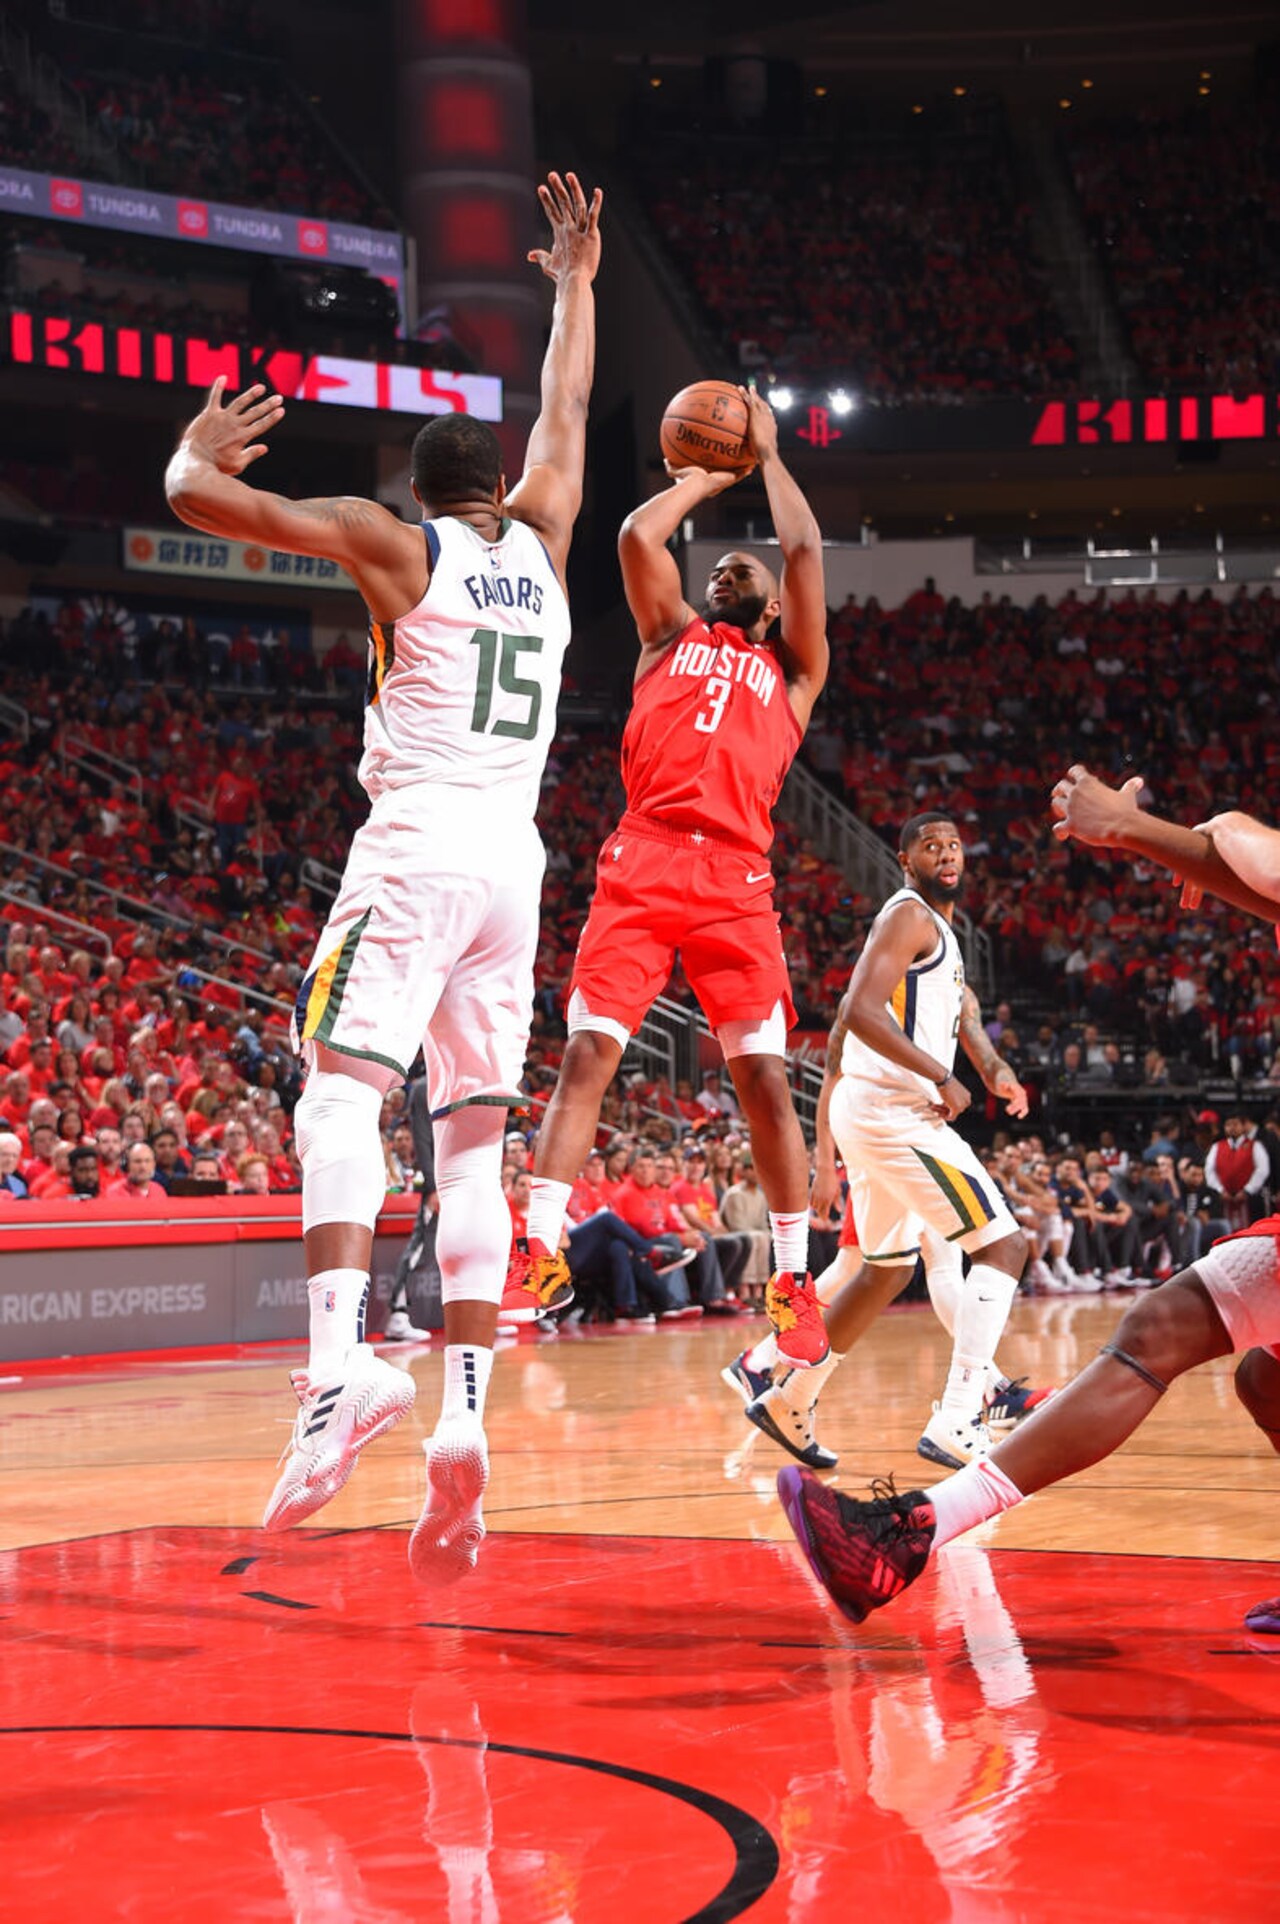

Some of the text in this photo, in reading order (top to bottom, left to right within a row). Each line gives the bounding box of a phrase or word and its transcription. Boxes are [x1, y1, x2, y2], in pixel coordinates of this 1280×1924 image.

[88, 194, 162, 221] TUNDRA
[213, 215, 283, 242] TUNDRA
[332, 234, 398, 260] TUNDRA
[469, 628, 544, 741] 15
[669, 641, 777, 708] HOUSTON
[693, 676, 732, 733] 3
[0, 1283, 207, 1325] RICAN EXPRESS
